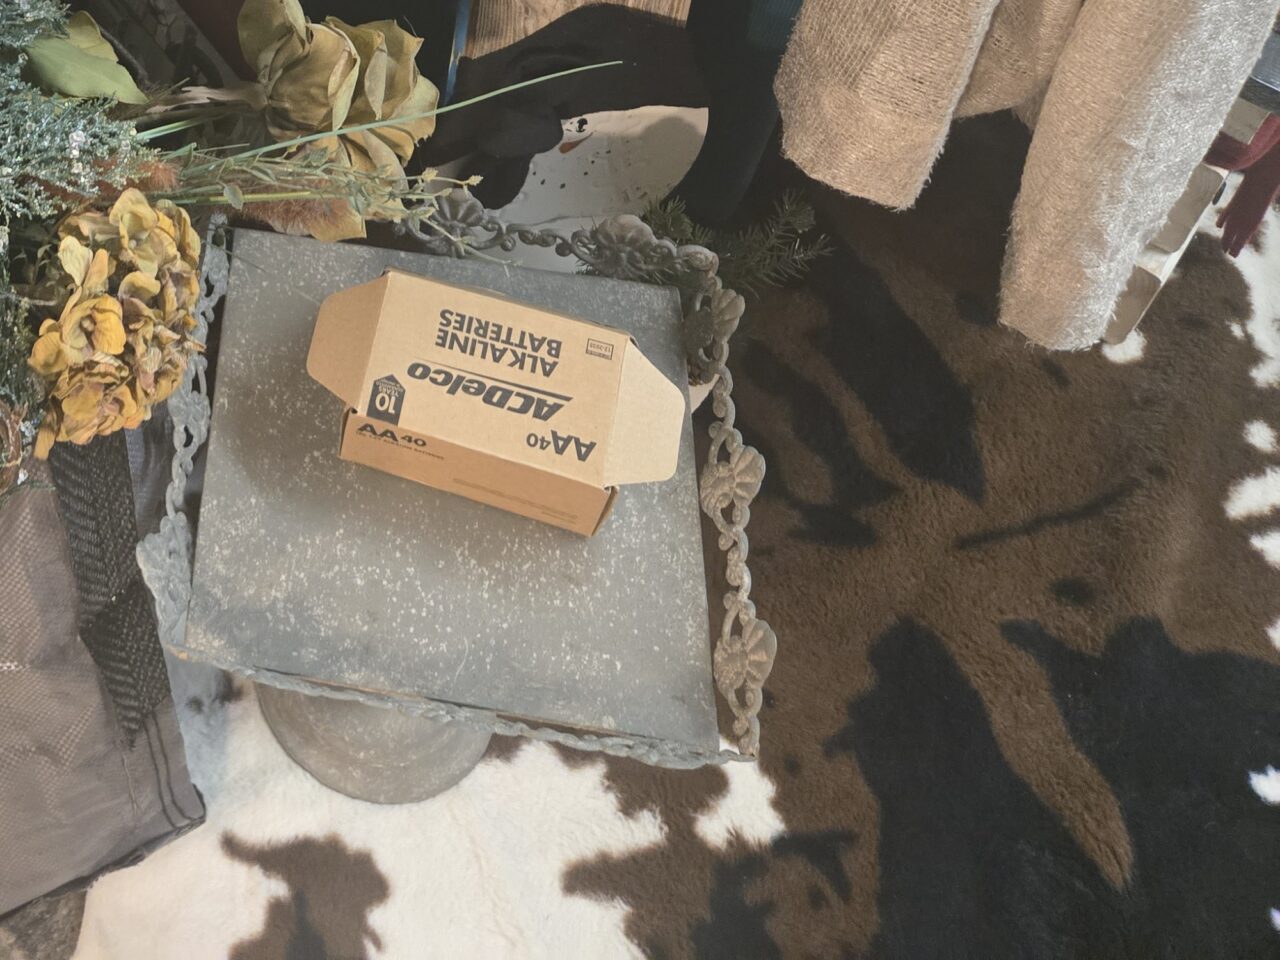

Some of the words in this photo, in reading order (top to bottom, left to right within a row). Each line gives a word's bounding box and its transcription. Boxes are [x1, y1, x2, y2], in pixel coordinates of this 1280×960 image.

[439, 309, 562, 359] BATTERIES
[435, 328, 559, 378] ALKALINE
[375, 393, 396, 414] 10
[407, 362, 565, 421] ACDelco
[358, 423, 398, 442] AA
[401, 434, 426, 447] 40
[526, 433, 550, 451] 40
[551, 429, 597, 462] AA
